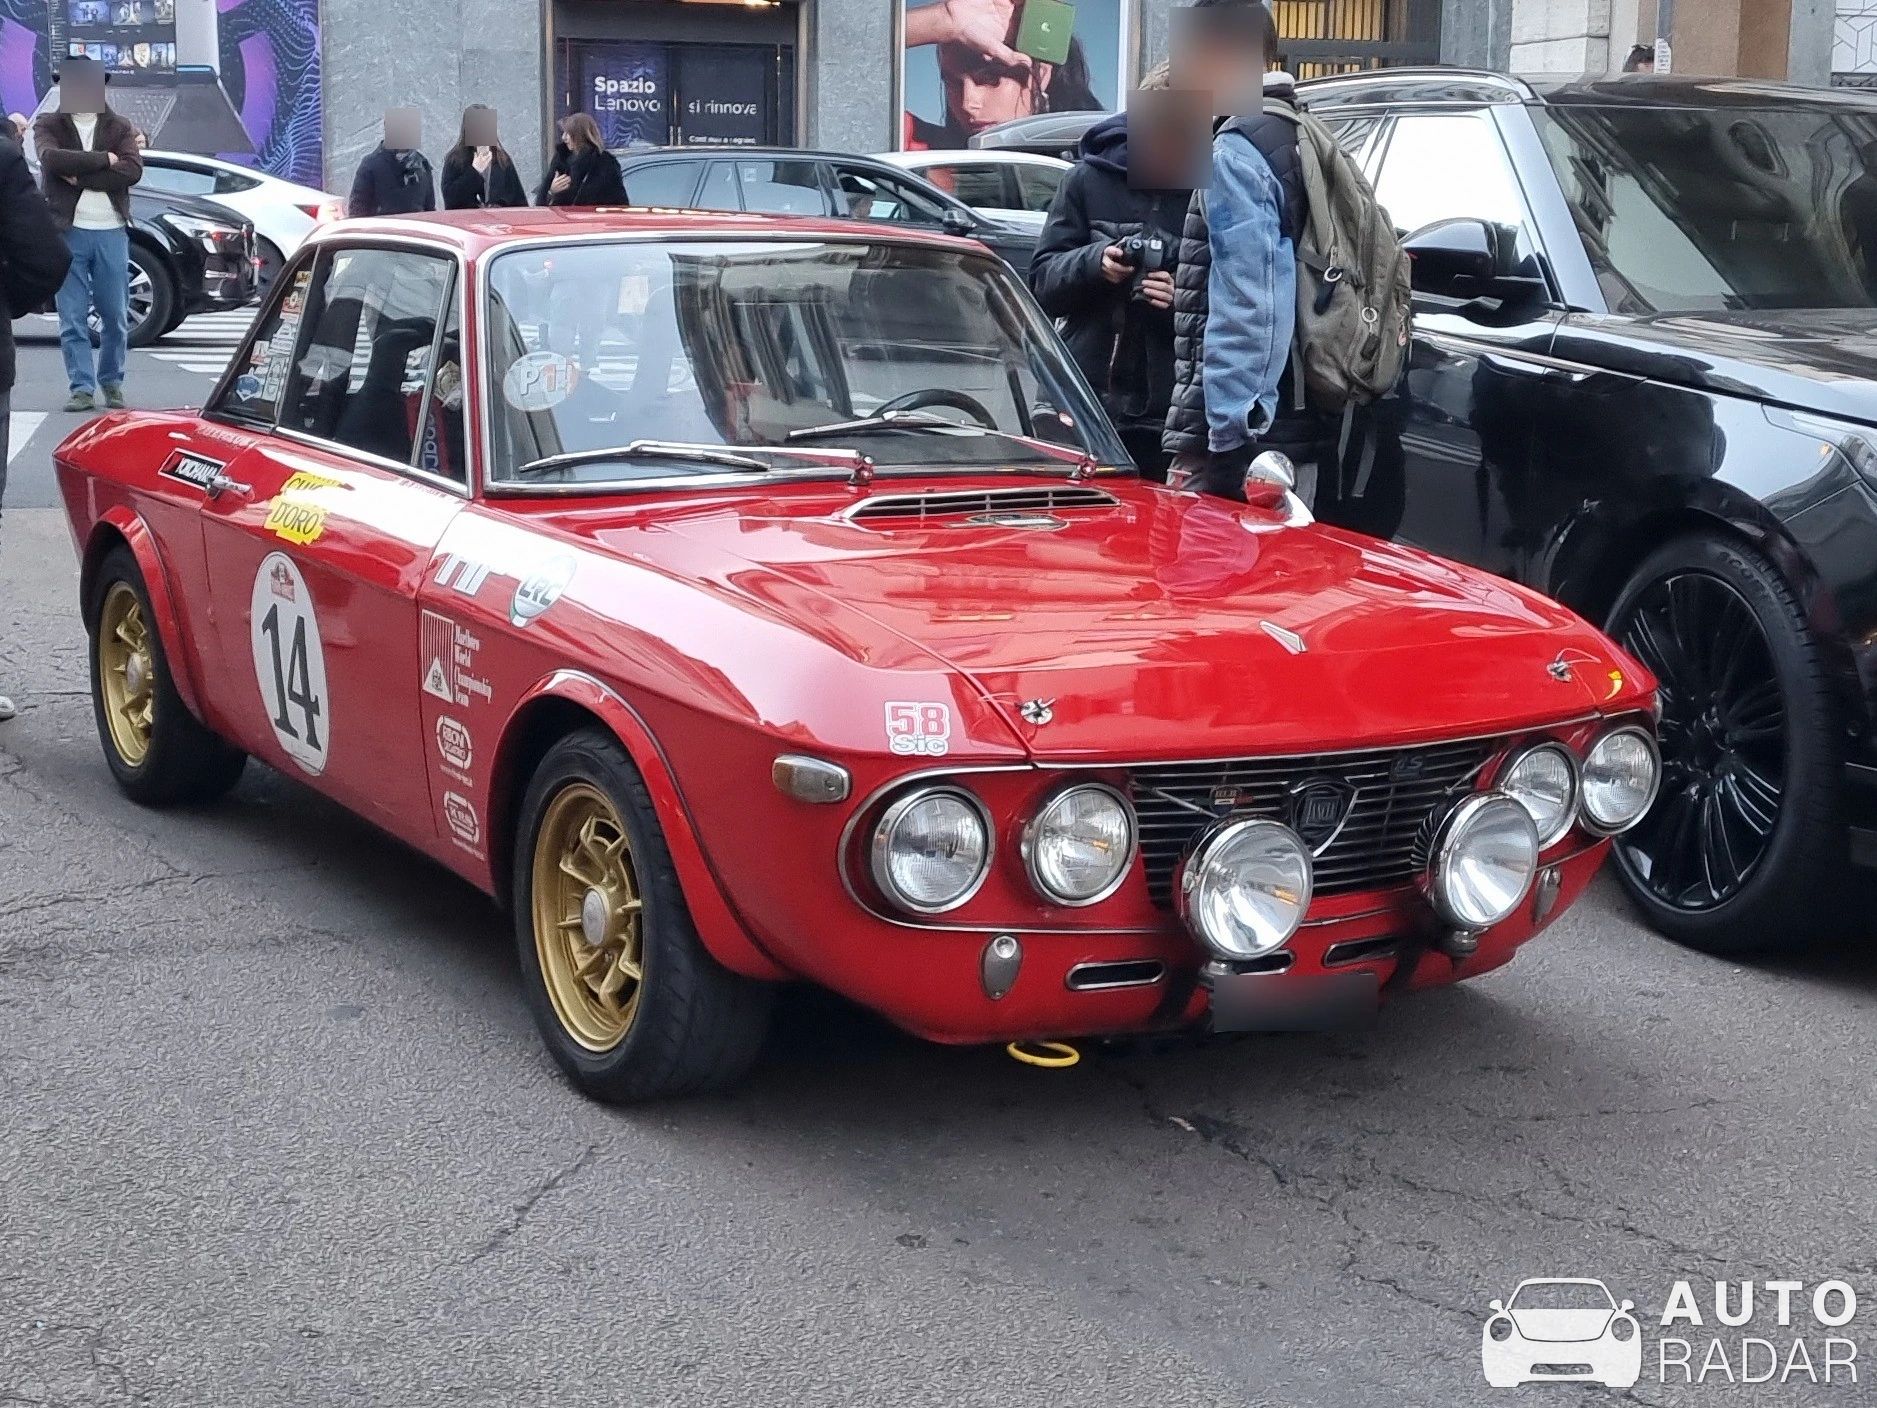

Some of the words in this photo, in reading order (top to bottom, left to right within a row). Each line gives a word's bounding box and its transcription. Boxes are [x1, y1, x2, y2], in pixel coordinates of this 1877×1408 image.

[594, 76, 656, 94] Spazio
[594, 95, 661, 112] Lenovo
[688, 100, 701, 114] si
[704, 100, 757, 115] rinnova
[272, 501, 320, 535] D'ORO
[262, 602, 322, 752] 14
[886, 702, 949, 736] 58
[891, 734, 948, 754] Sic
